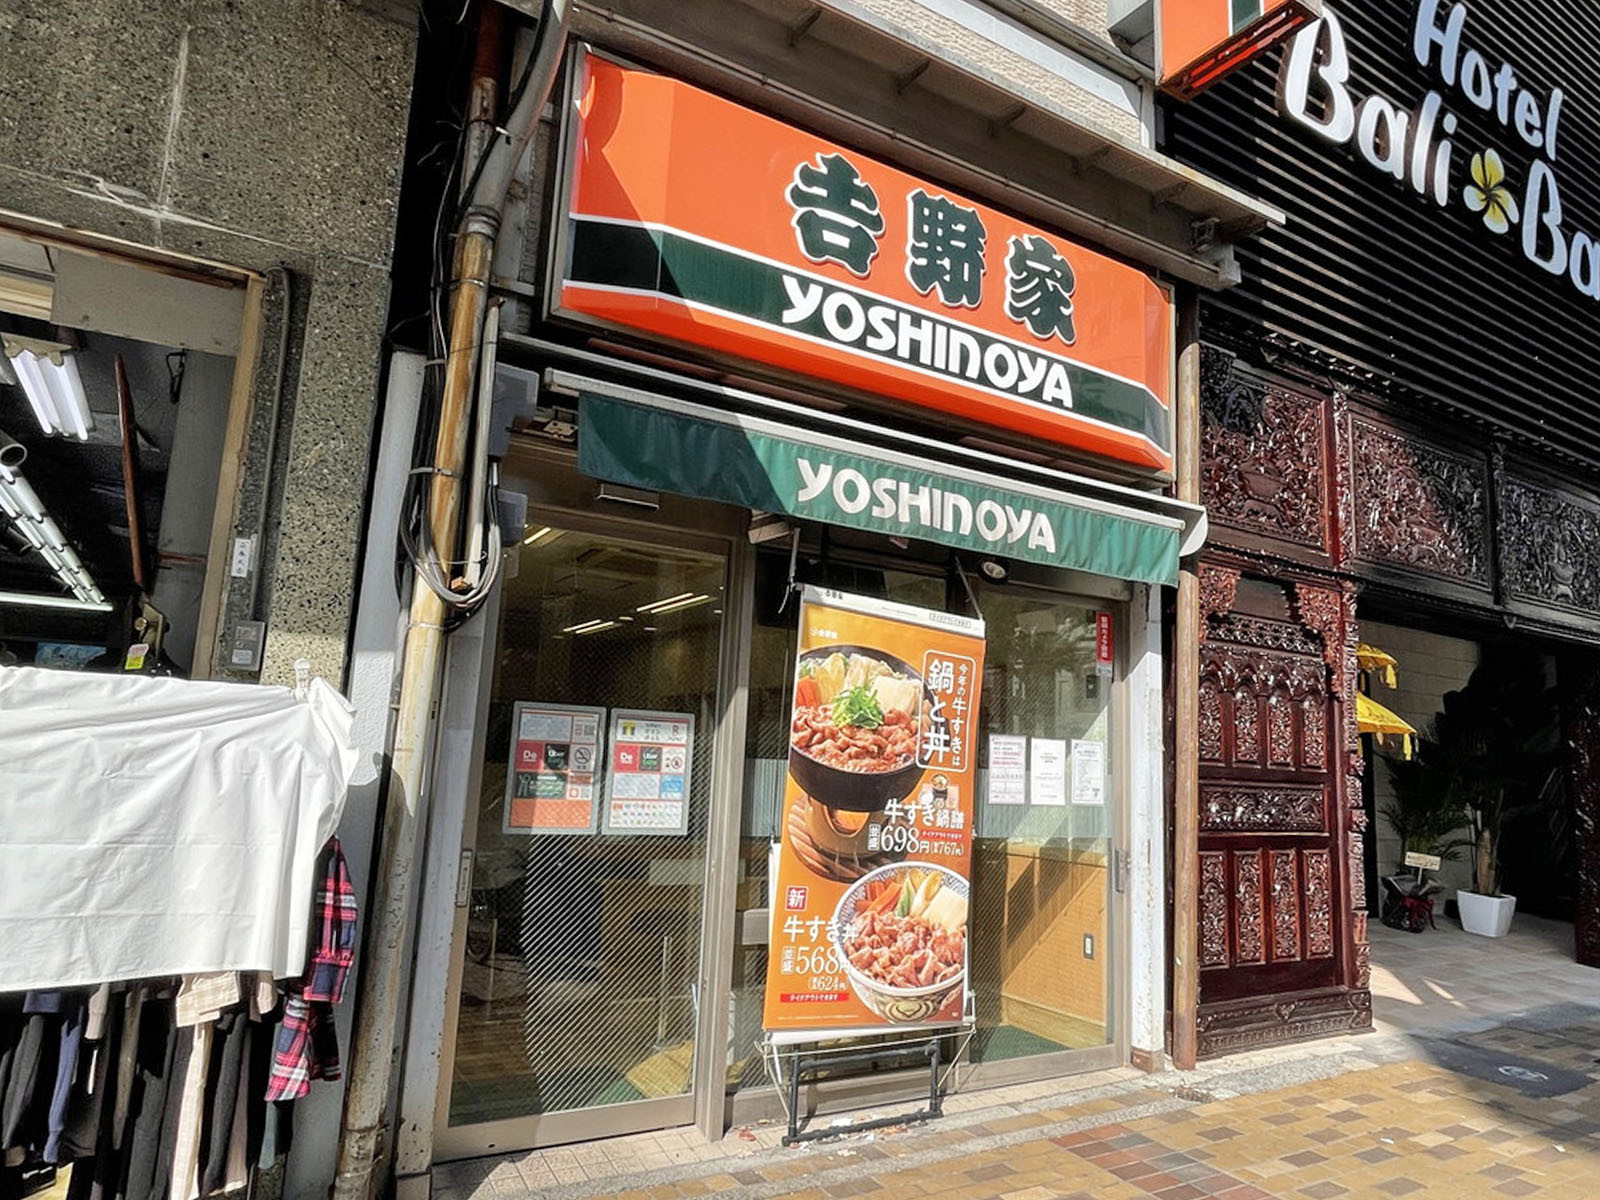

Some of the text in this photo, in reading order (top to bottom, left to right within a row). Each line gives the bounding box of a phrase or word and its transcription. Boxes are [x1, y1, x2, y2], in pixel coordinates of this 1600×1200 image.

[1414, 0, 1564, 161] Hotel
[1284, 6, 1600, 301] Bali Ba
[785, 152, 1078, 345] 吉野家
[781, 275, 1074, 409] YOSHINOYA
[797, 458, 1056, 554] YOSHINOYA
[922, 658, 954, 763] 鍋と丼
[951, 663, 968, 767] 今年の牛すきは
[787, 888, 807, 910] 新
